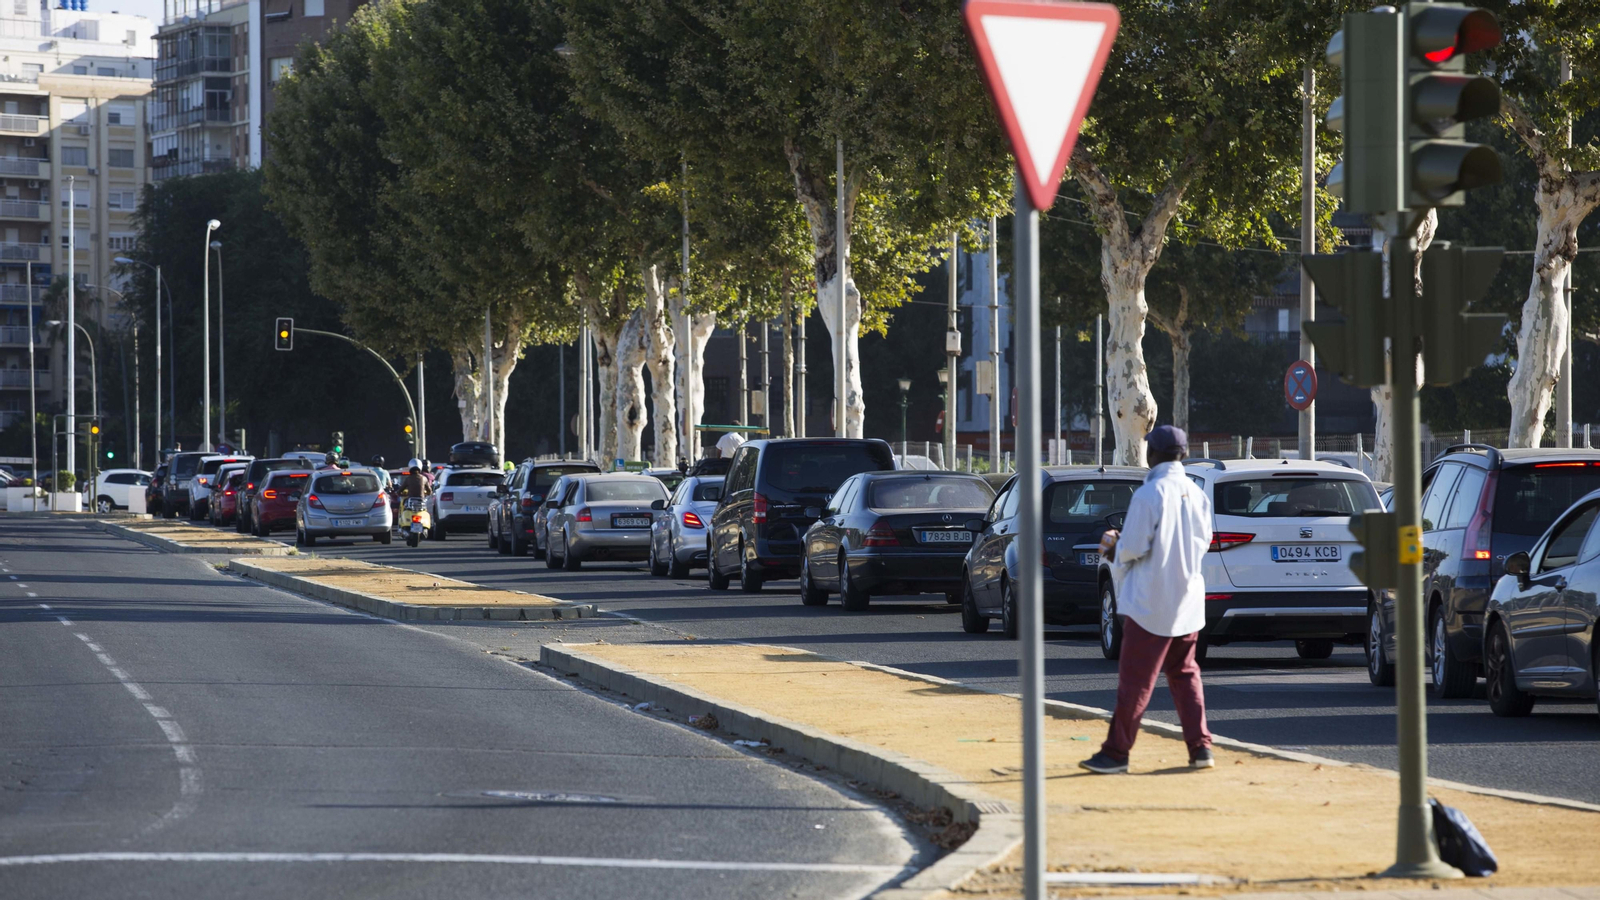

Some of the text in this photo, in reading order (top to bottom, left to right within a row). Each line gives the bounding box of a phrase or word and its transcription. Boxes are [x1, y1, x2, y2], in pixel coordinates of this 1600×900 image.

[928, 532, 970, 541] 7829 BJB
[1280, 546, 1338, 558] 0494 KCB
[1086, 554, 1100, 564] 58
